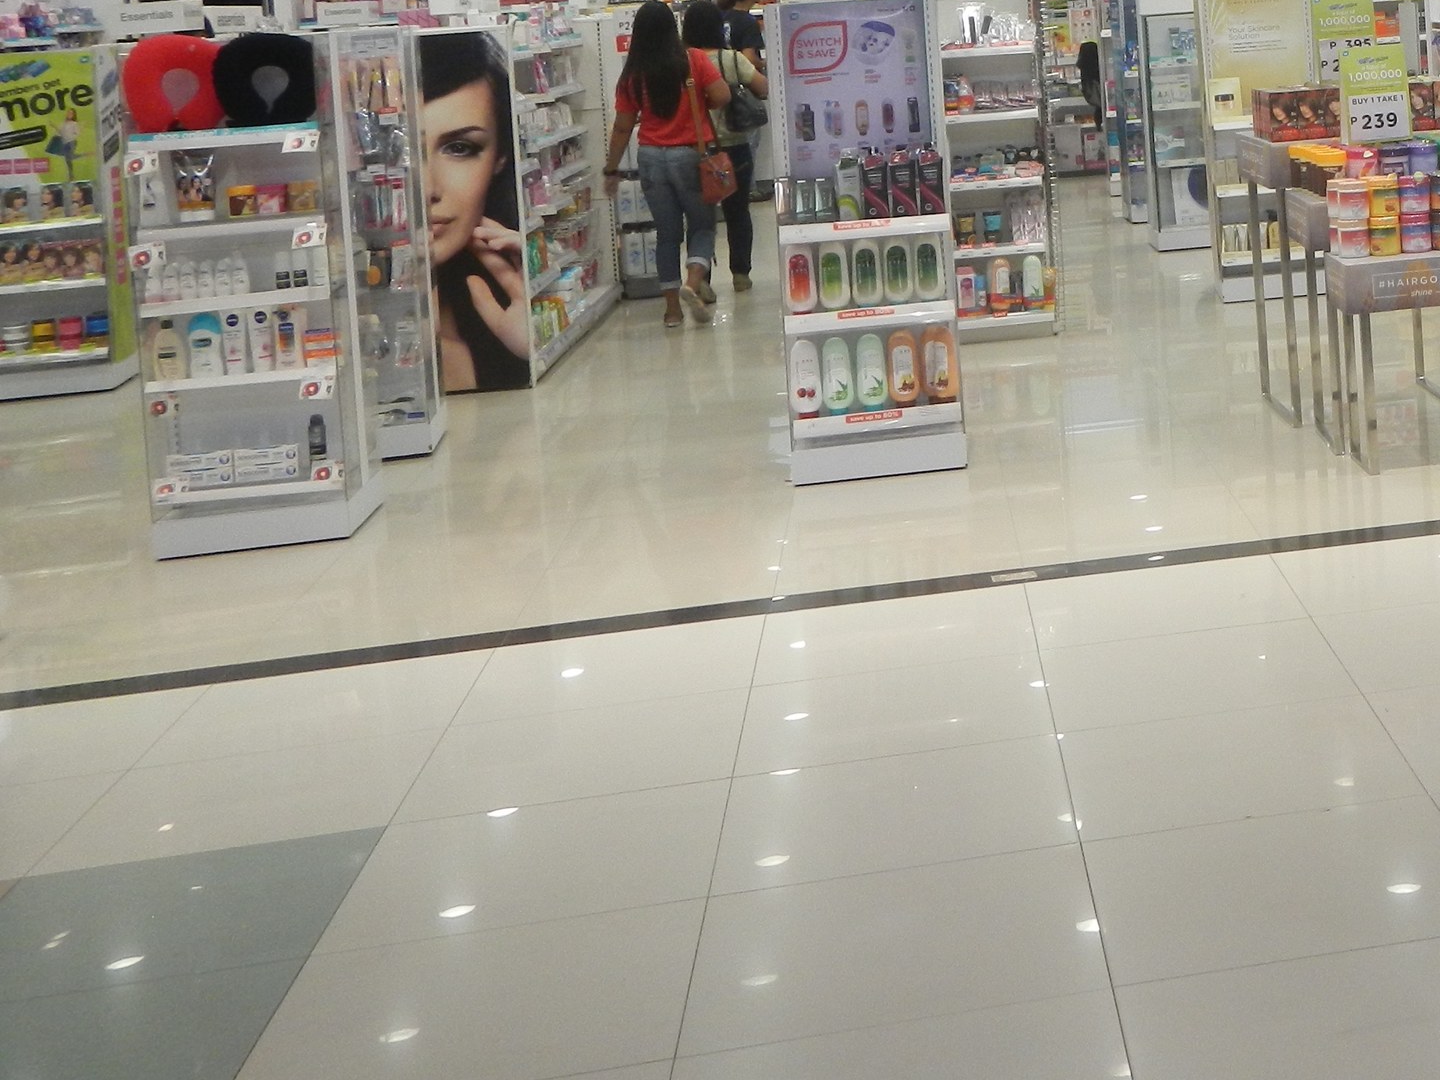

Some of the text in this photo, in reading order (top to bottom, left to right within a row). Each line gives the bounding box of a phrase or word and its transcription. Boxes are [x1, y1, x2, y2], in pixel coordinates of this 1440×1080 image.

[796, 37, 842, 48] SWITCH
[808, 48, 836, 59] SAVE
[1361, 112, 1398, 130] 239
[1410, 287, 1433, 298] shine
